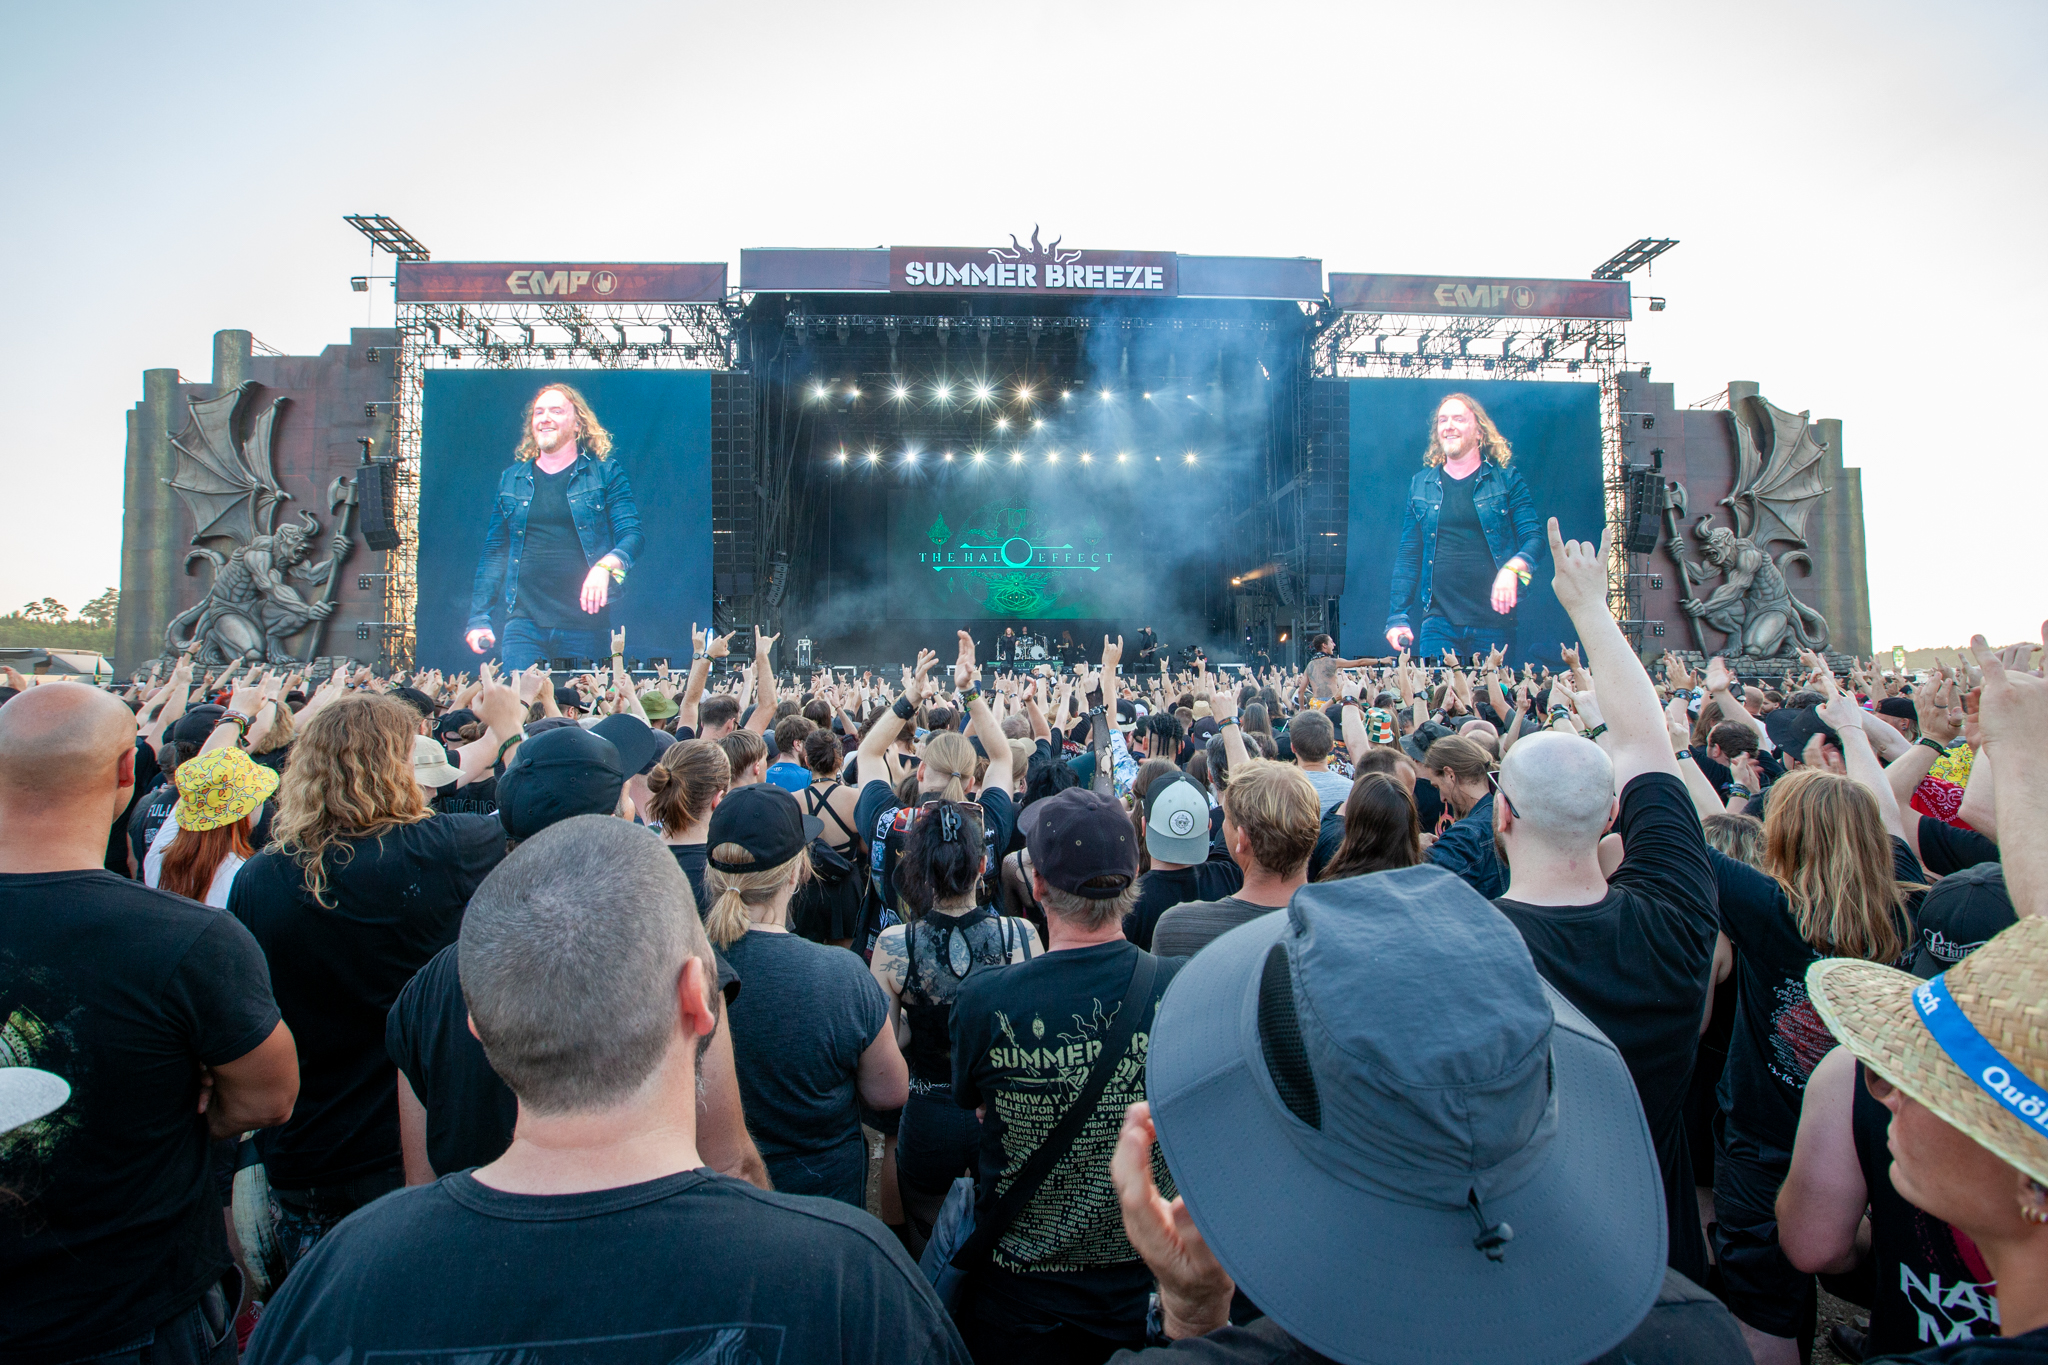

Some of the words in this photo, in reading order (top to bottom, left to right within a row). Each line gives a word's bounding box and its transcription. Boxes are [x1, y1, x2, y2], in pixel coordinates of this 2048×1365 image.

[506, 270, 591, 295] EMP
[905, 261, 1037, 287] SUMMER
[1045, 263, 1163, 290] BREEZE
[1433, 283, 1510, 308] EMP
[918, 552, 955, 563] THE
[1038, 552, 1113, 563] EFFECT
[990, 1040, 1103, 1069] SUMMER
[995, 1097, 1027, 1114] BULLET
[1031, 1105, 1054, 1115] FOR
[1097, 1093, 1145, 1104] ENTINE
[996, 1089, 1062, 1105] PARKWAY
[1000, 1115, 1032, 1128] EMPEROR
[1014, 1112, 1055, 1122] DIAMOND
[1007, 1131, 1038, 1143] CRADLE
[1055, 1162, 1074, 1170] EAST
